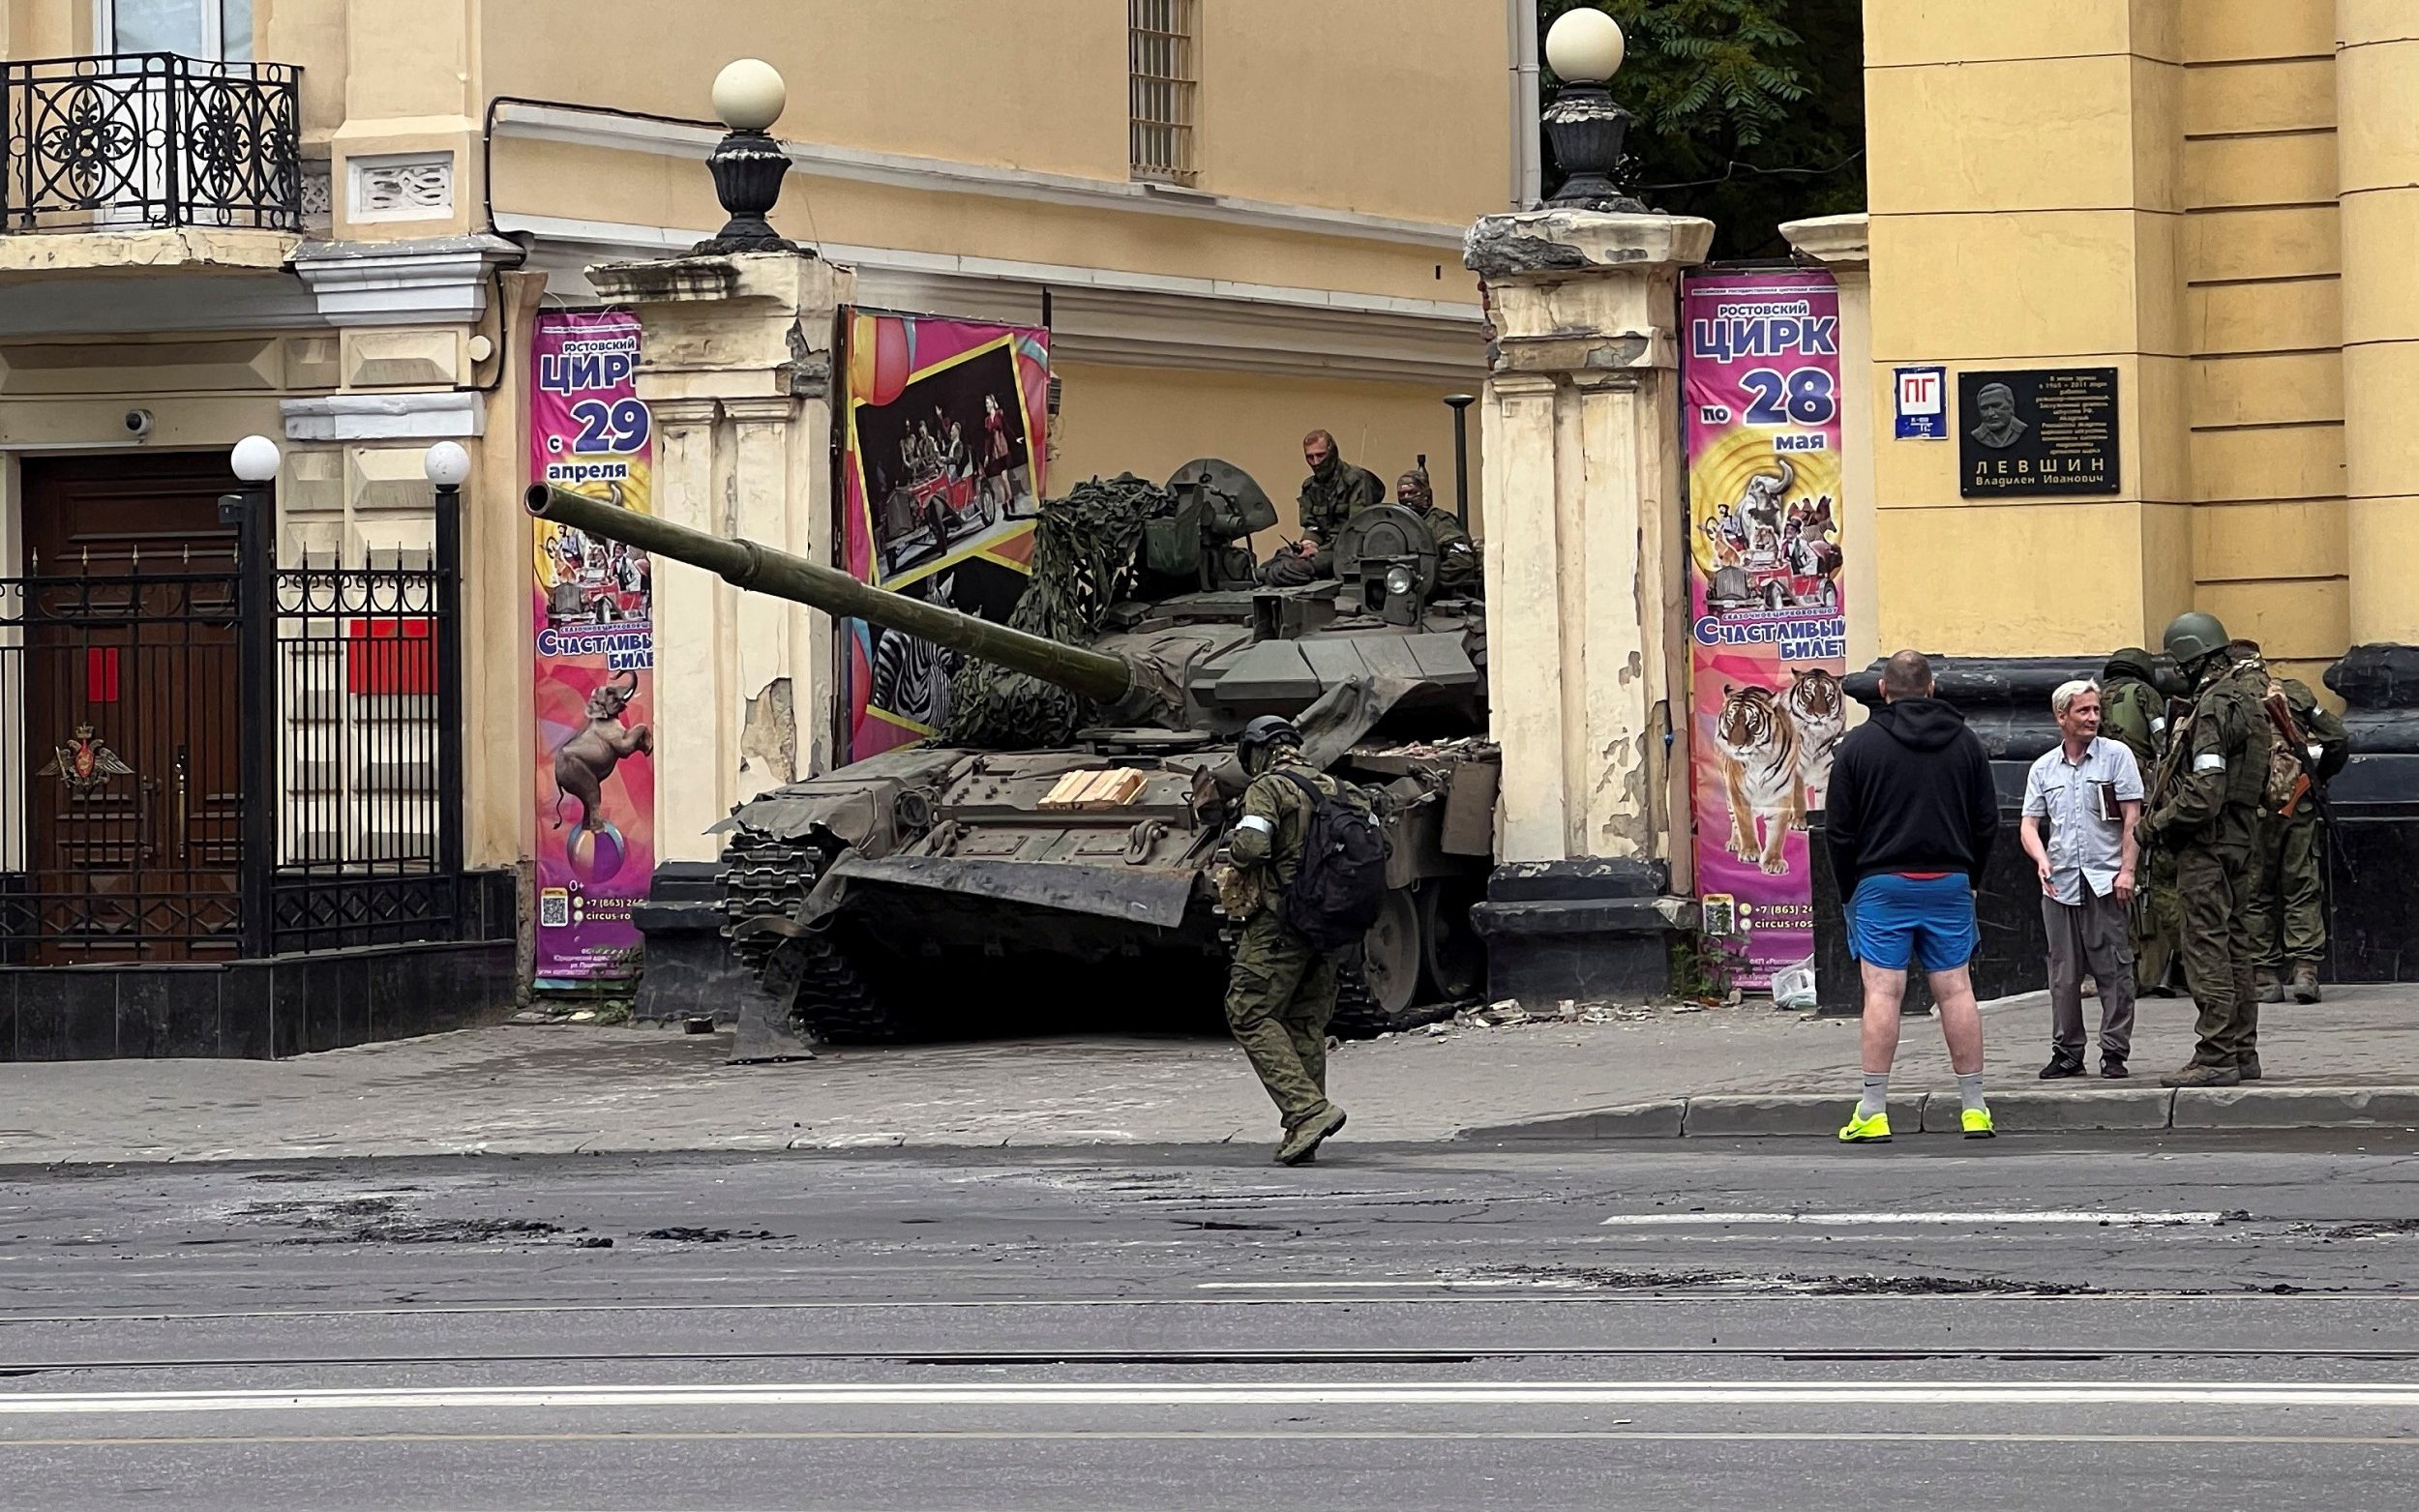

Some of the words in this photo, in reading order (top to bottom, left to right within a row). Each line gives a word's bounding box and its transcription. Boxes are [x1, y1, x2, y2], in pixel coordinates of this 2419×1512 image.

[1719, 302, 1807, 316] РОСТОВСКИЙ
[1693, 318, 1837, 362] ЦИРК
[1702, 407, 1729, 422] по
[1741, 369, 1834, 424] 28
[1904, 378, 1935, 402] ПГ
[549, 437, 560, 450] с
[572, 400, 649, 453] 29
[1776, 434, 1824, 450] мая
[549, 464, 627, 483] апреля
[1976, 458, 2105, 475] ЛЕВШИН
[1976, 476, 2035, 488] Владилен
[2044, 474, 2104, 485] Иванович
[569, 879, 584, 892] 0+
[600, 898, 624, 908] (863)
[1755, 905, 1768, 914] +7
[1771, 904, 1799, 916] (863)
